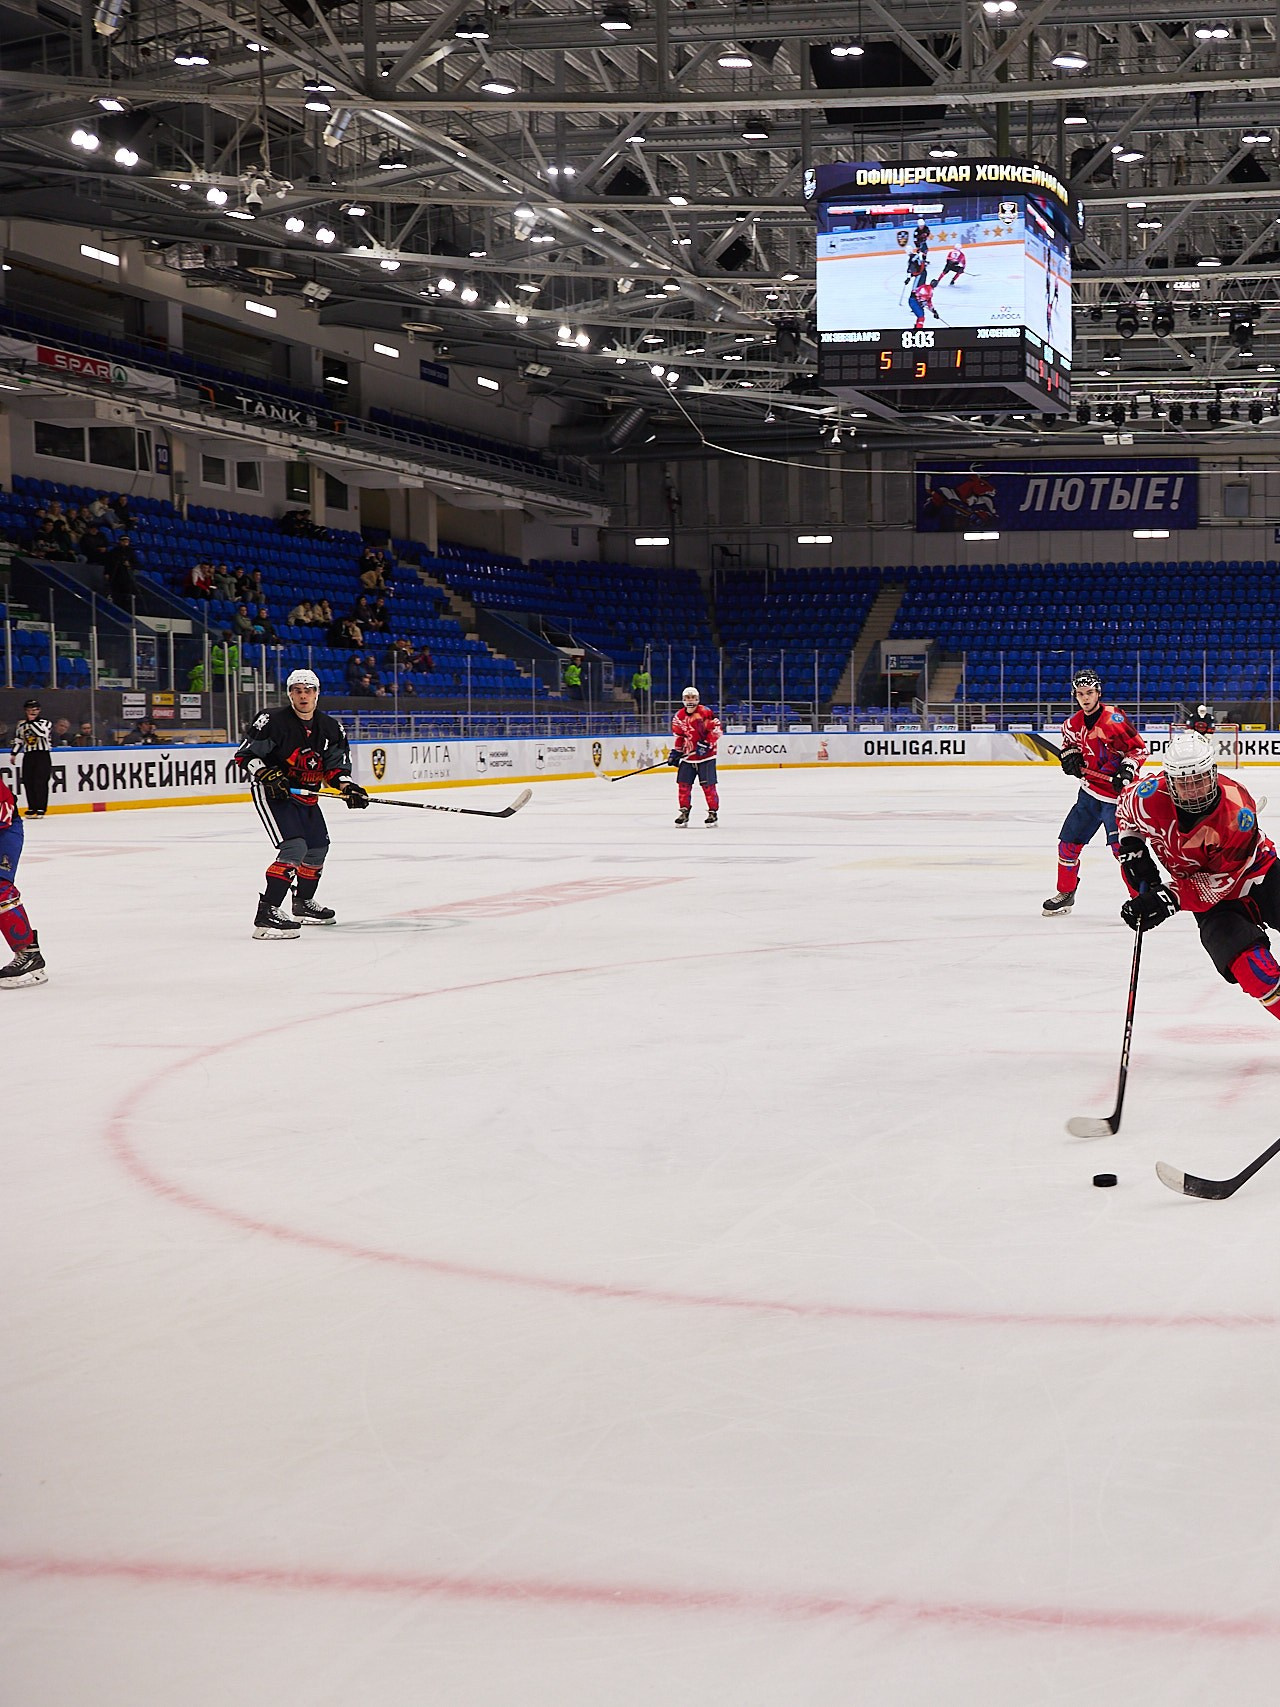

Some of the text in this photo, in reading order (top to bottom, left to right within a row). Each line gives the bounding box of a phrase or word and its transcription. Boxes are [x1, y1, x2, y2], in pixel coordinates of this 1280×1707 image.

[856, 165, 970, 186] ОФИЦЕРСКАЯ
[901, 331, 935, 348] 8:03
[54, 354, 111, 379] SPAR
[880, 351, 893, 370] 5
[955, 349, 963, 368] 1
[915, 362, 927, 378] 3
[235, 396, 302, 427] TANK
[1019, 477, 1184, 511] ЛЮТЫЕ!
[410, 745, 451, 764] ЛИГА
[864, 740, 966, 756] OHLIGA.RU
[78, 753, 216, 792] ХОККЕЙНАЯ
